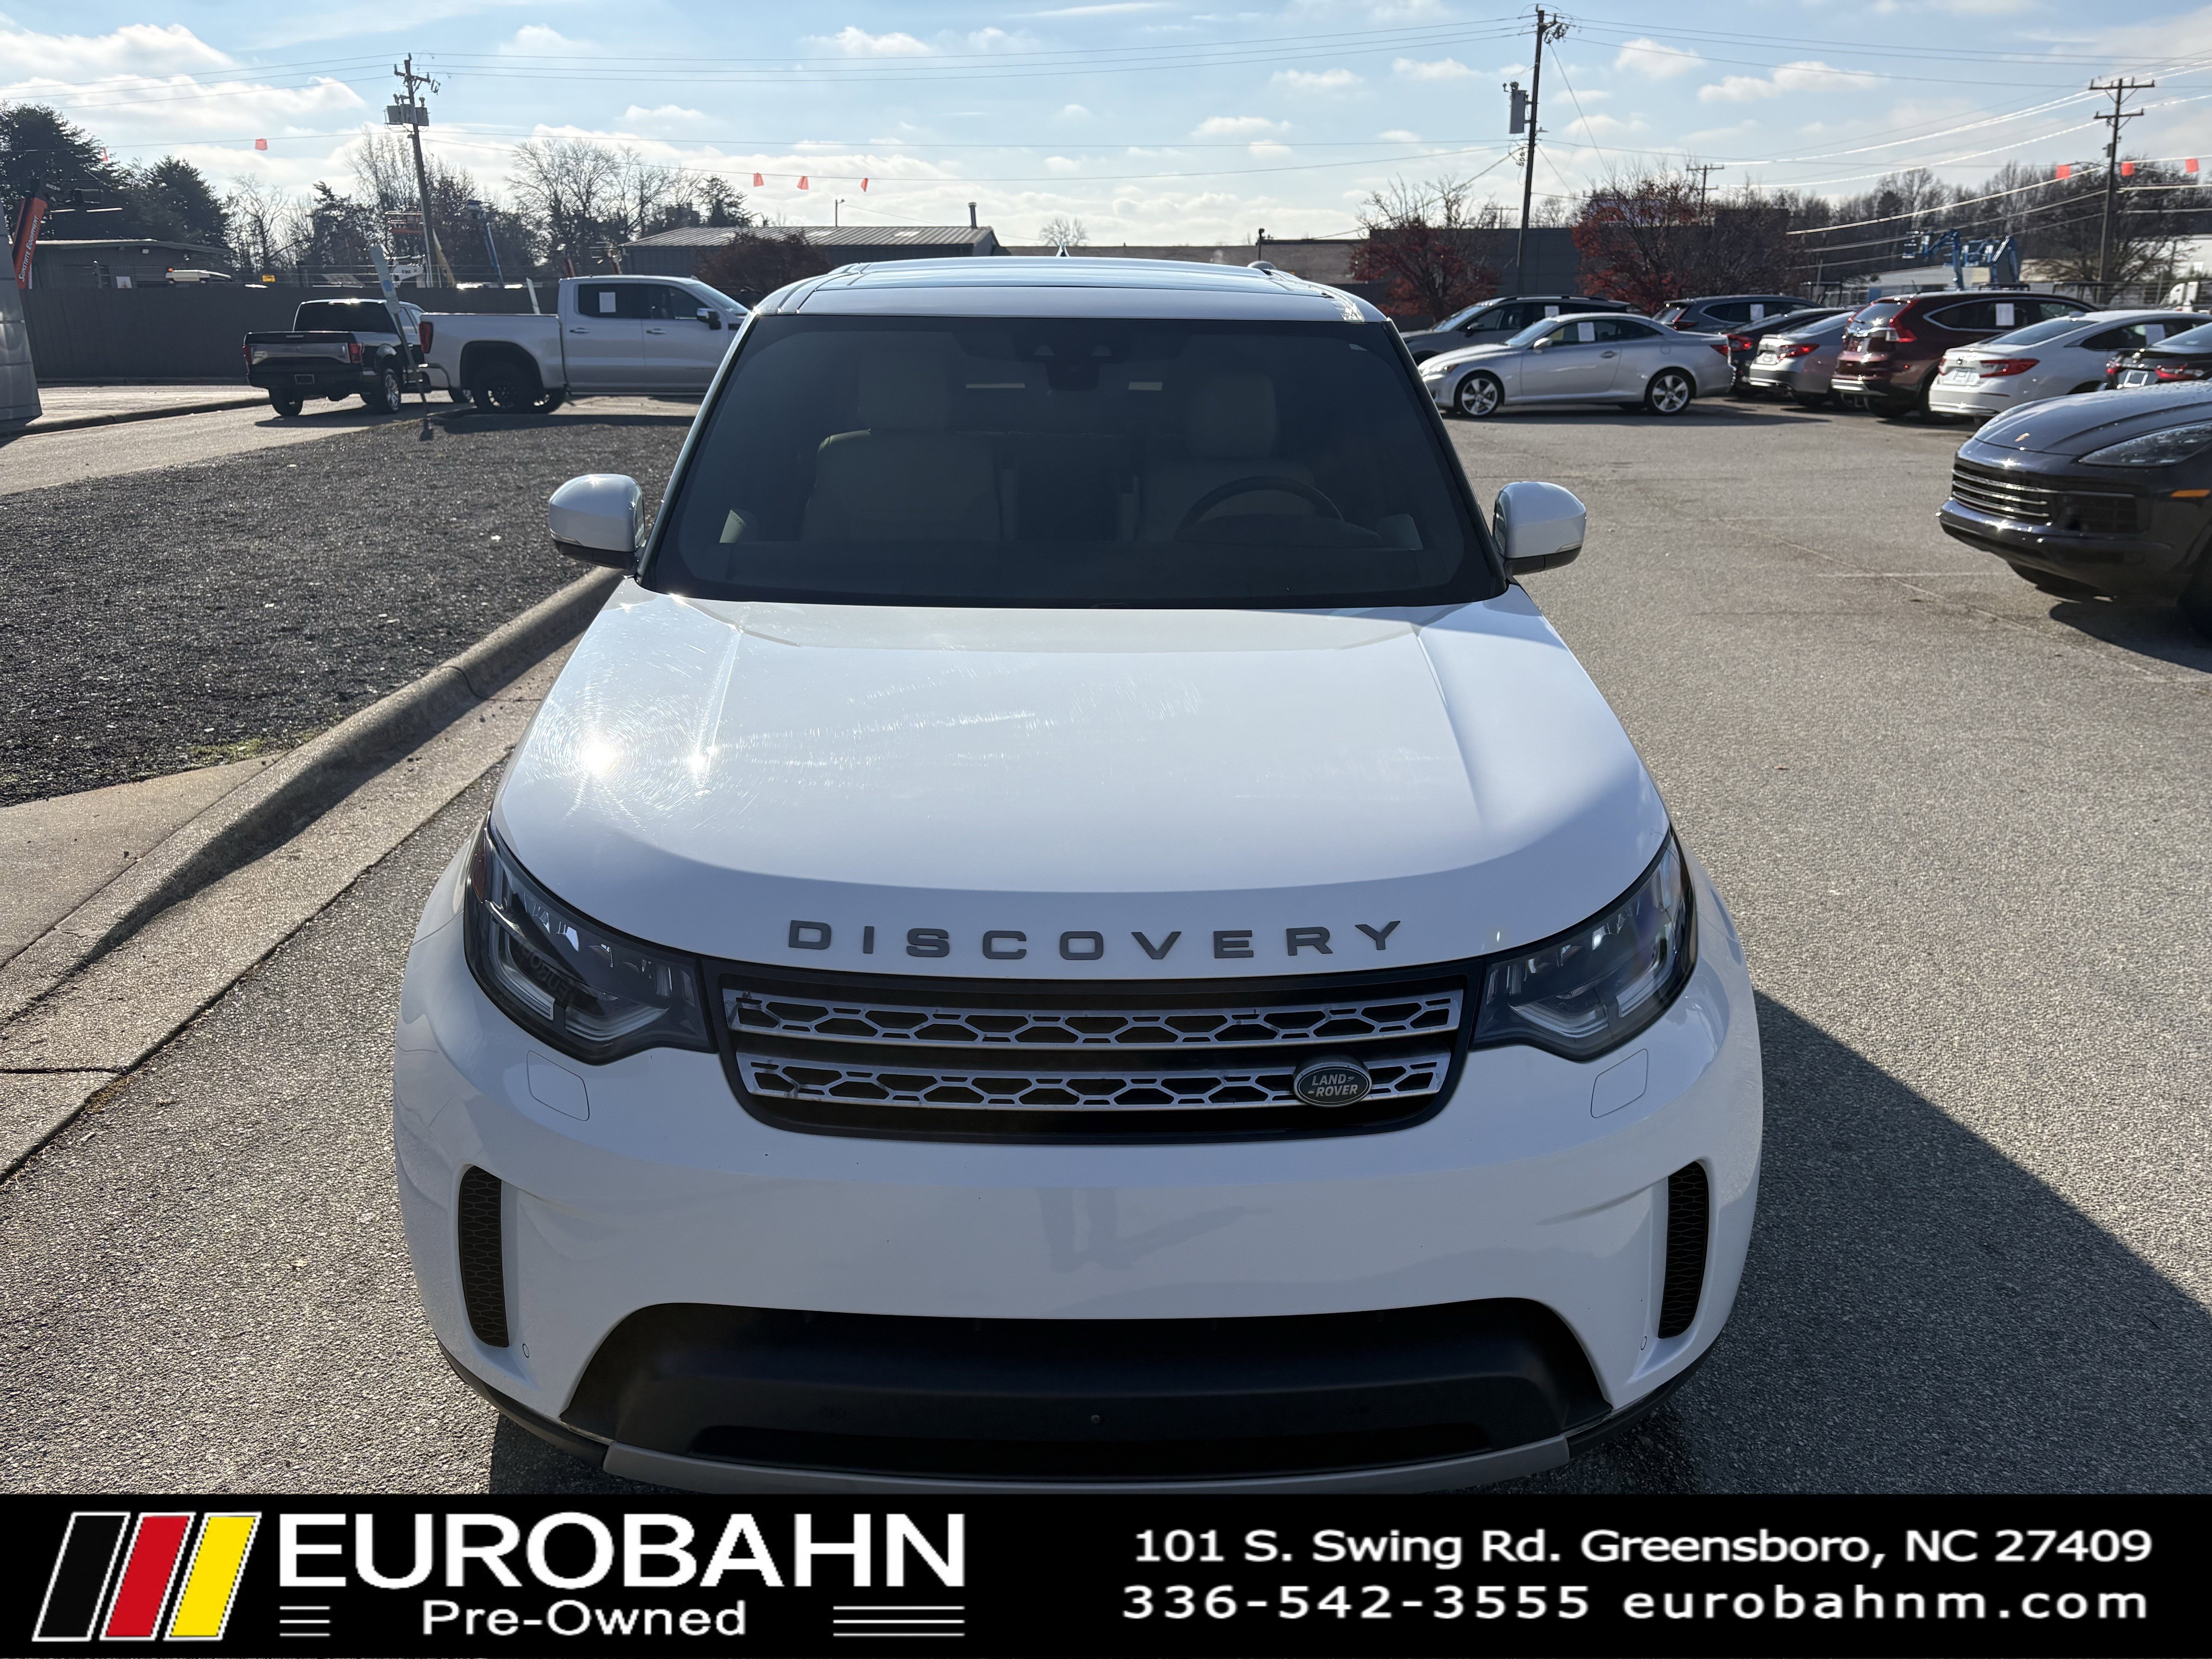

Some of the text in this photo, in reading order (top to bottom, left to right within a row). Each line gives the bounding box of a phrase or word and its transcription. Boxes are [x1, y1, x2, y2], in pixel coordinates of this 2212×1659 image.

[787, 919, 1401, 961] DISCOVERY
[1312, 1073, 1346, 1085] LAND
[1316, 1084, 1358, 1097] ROVER
